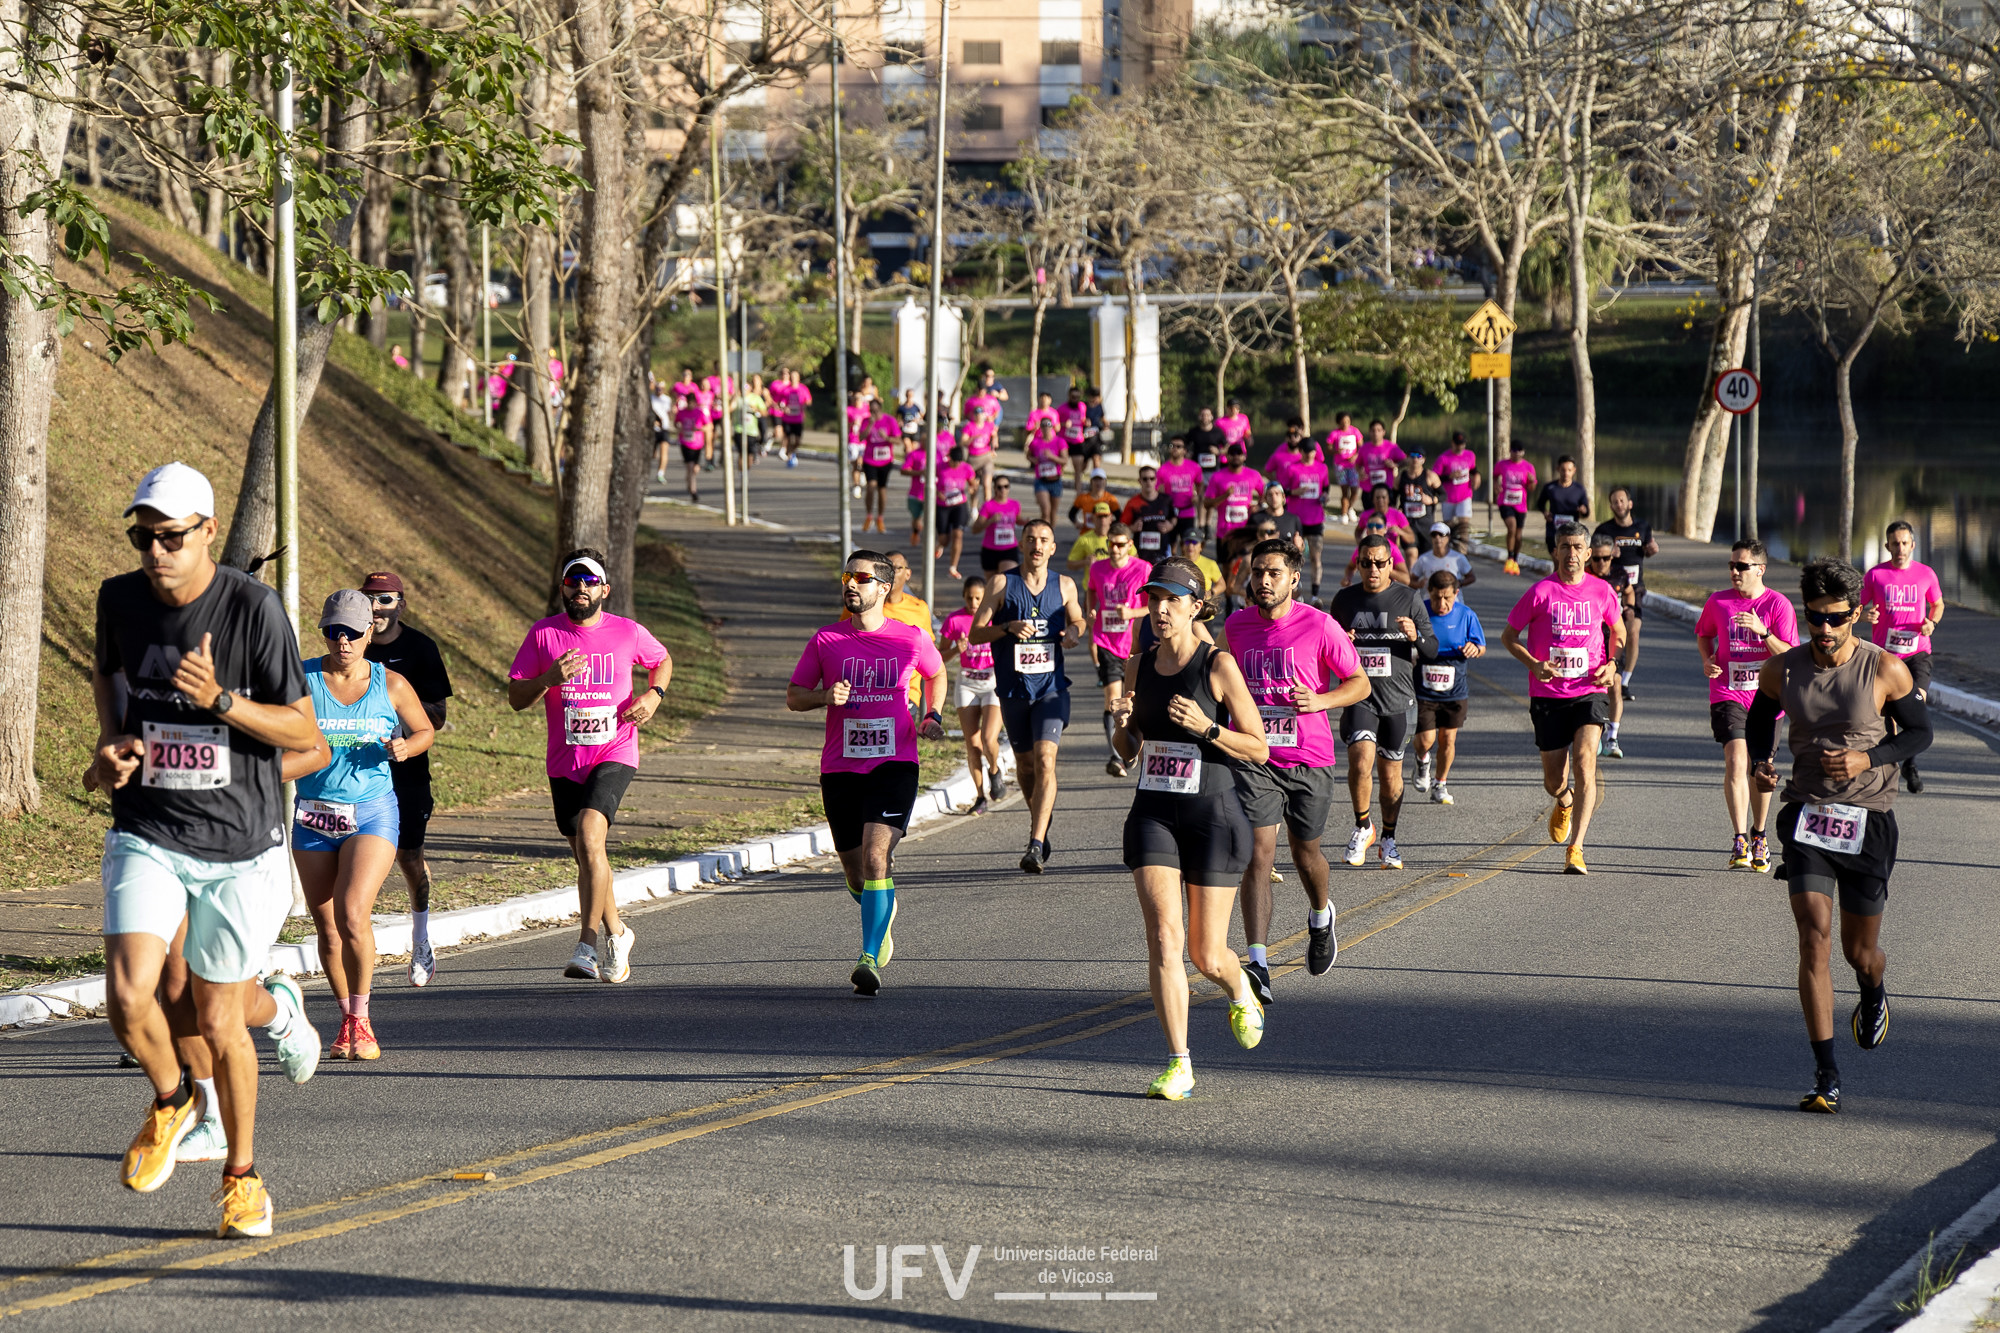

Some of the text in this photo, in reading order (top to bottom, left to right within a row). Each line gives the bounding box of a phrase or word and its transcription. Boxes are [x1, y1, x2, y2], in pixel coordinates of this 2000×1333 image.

[1727, 376, 1749, 399] 40
[1021, 653, 1050, 665] 2243
[561, 692, 612, 700] MARATONA
[848, 694, 893, 703] ARATONA
[572, 718, 608, 733] 2221
[1263, 718, 1293, 734] 314
[850, 730, 887, 746] 2315
[153, 743, 215, 769] 2039
[1148, 756, 1192, 777] 2387
[304, 811, 348, 831] 2096
[1806, 814, 1854, 840] 2153
